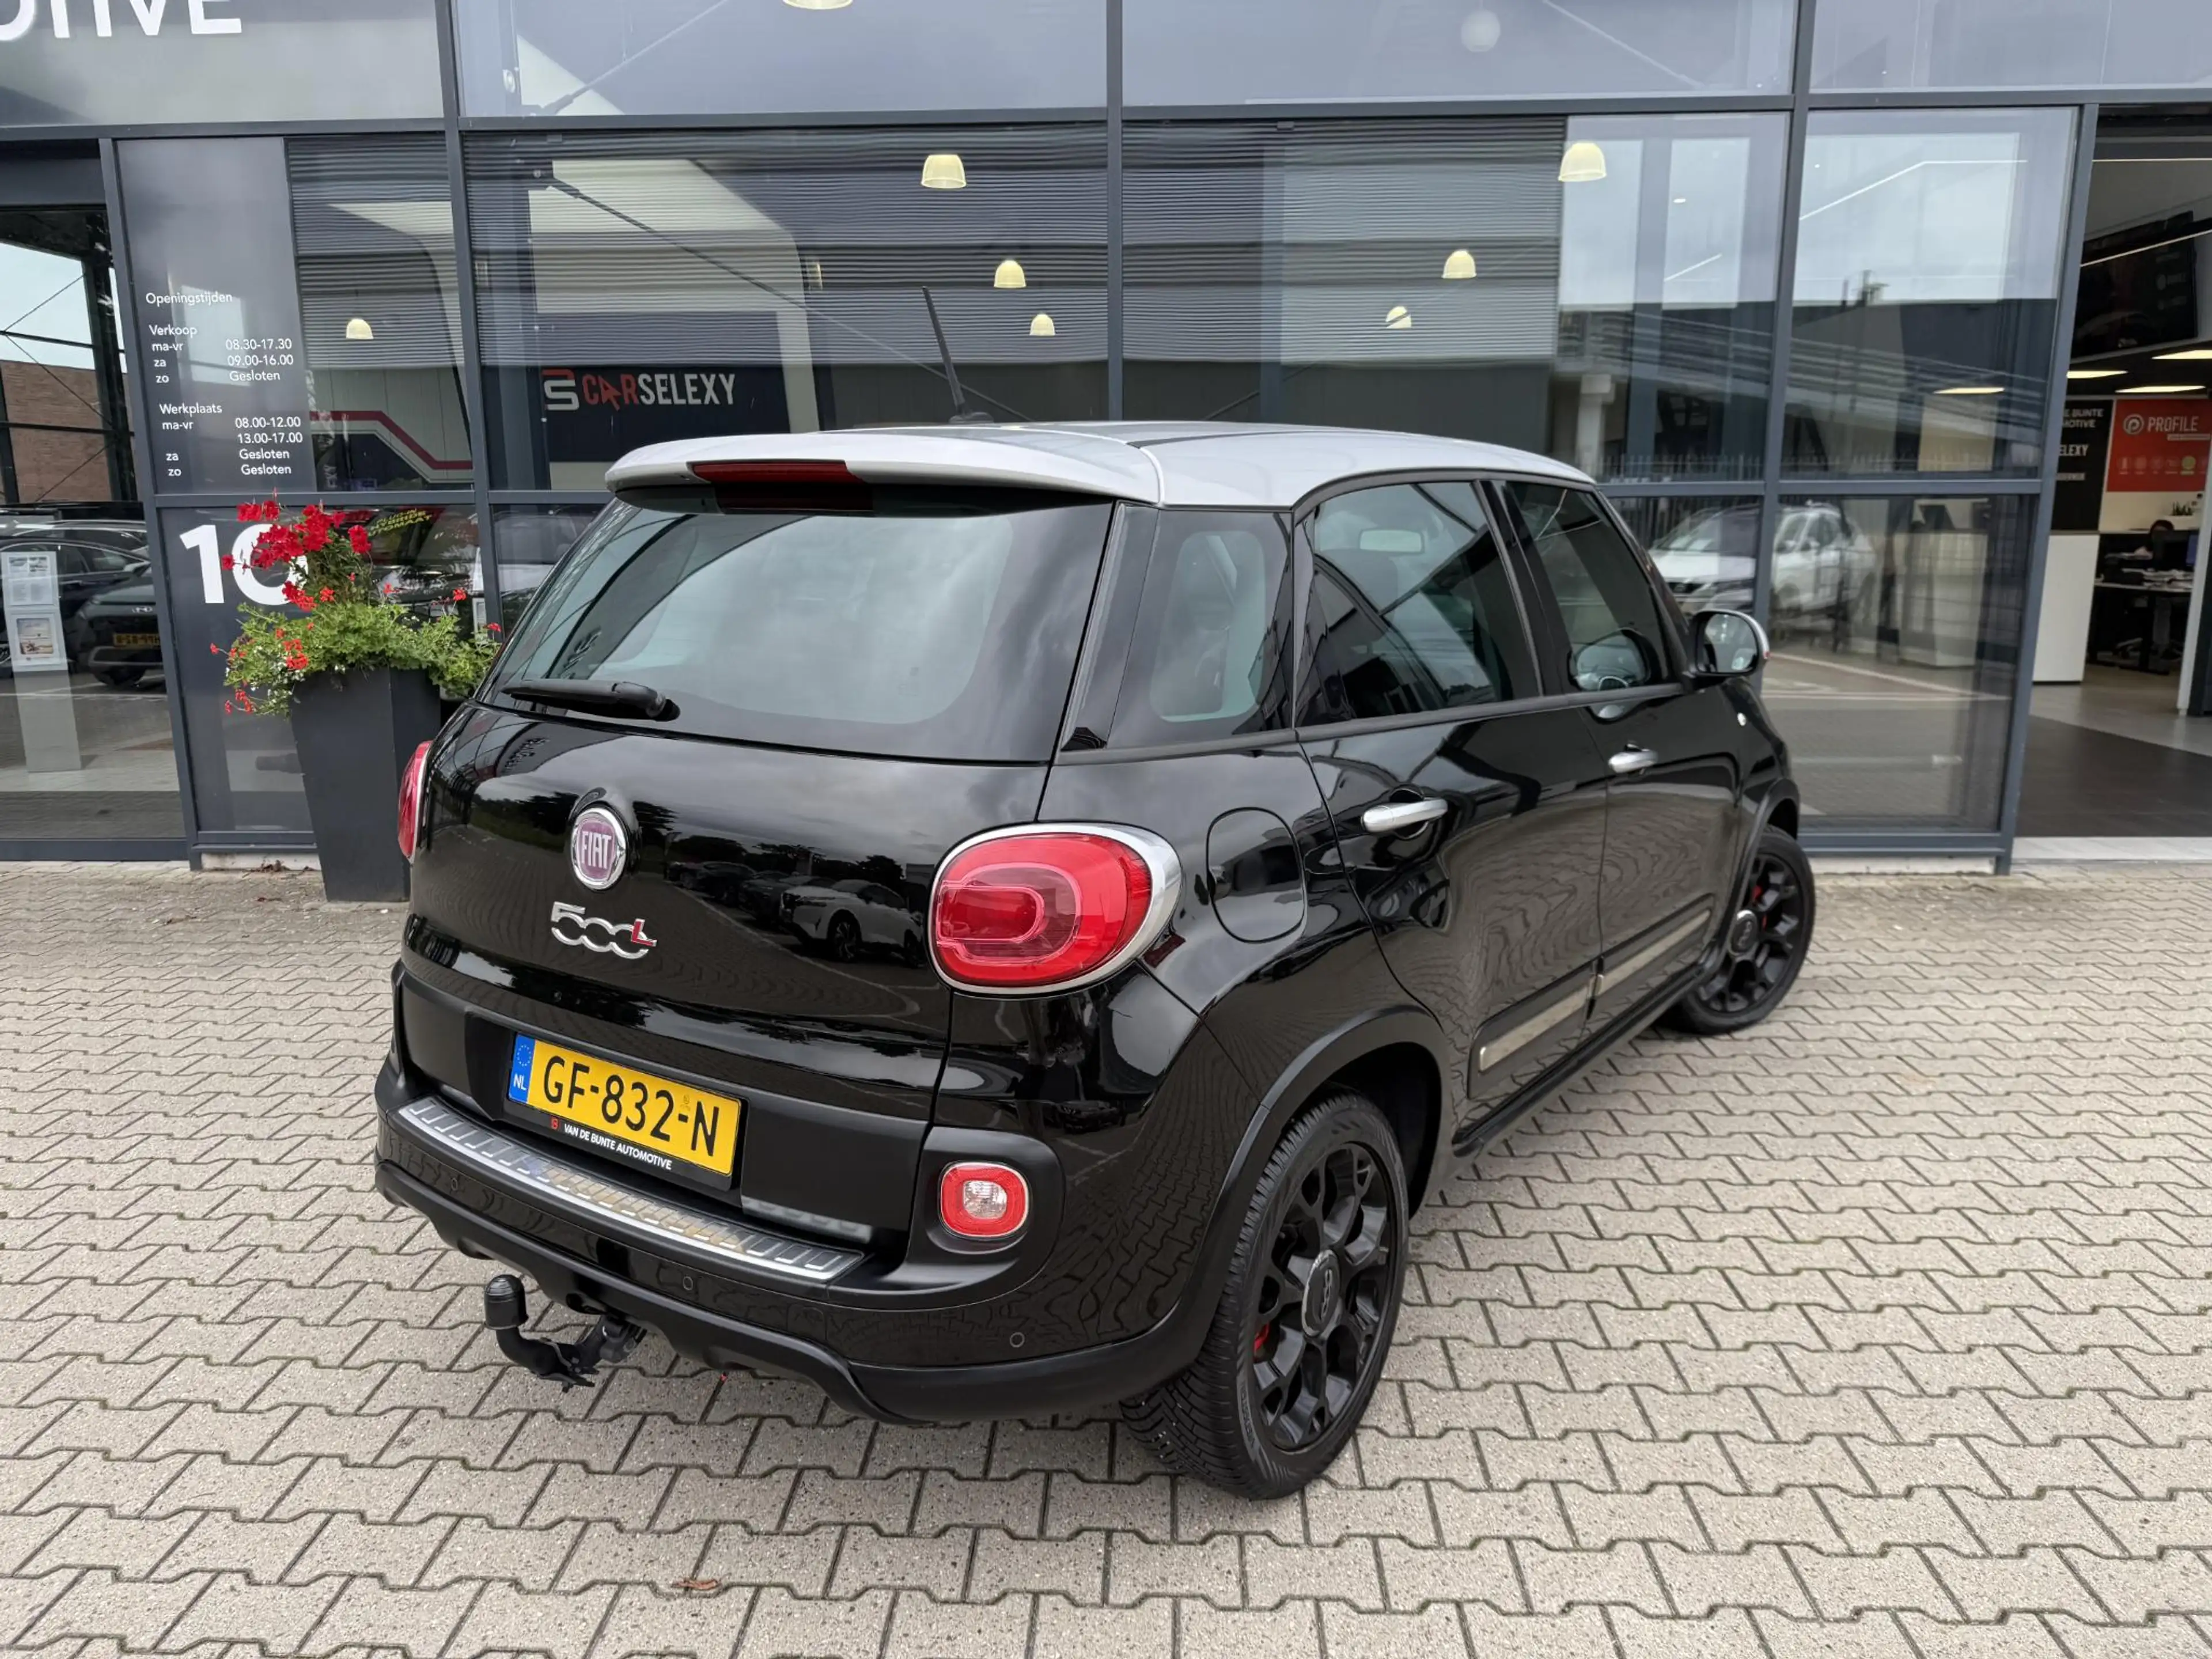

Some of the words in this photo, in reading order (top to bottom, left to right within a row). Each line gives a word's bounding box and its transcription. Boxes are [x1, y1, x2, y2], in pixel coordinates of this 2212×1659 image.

[146, 291, 232, 307] Openingstijden
[149, 324, 198, 338] Verkoop
[152, 342, 183, 351] ma-vr
[225, 338, 292, 350] 08.30-17.30
[153, 359, 166, 368] za
[227, 354, 294, 366] 09.00-16.00
[156, 375, 169, 384] zo
[229, 369, 281, 381] Gesloten
[158, 402, 223, 418] Werkplaats
[162, 421, 194, 430] ma-vr
[235, 416, 301, 429] 08.00-12.00
[2147, 416, 2199, 432] PROFILE
[237, 431, 303, 444] 13.00-17.00
[166, 452, 179, 461] za
[239, 448, 289, 460] Gesloten
[168, 467, 181, 476] zo
[241, 463, 291, 475] Gesloten
[179, 524, 309, 605] 10
[582, 831, 612, 869] FIAT
[551, 902, 657, 960] 500L
[513, 1073, 527, 1091] NL
[543, 1055, 719, 1157] GF-832-N
[565, 1124, 578, 1137] VAN
[579, 1131, 590, 1141] DE
[591, 1133, 616, 1150] BUNTE
[616, 1142, 673, 1171] AUTOMOTIVE
